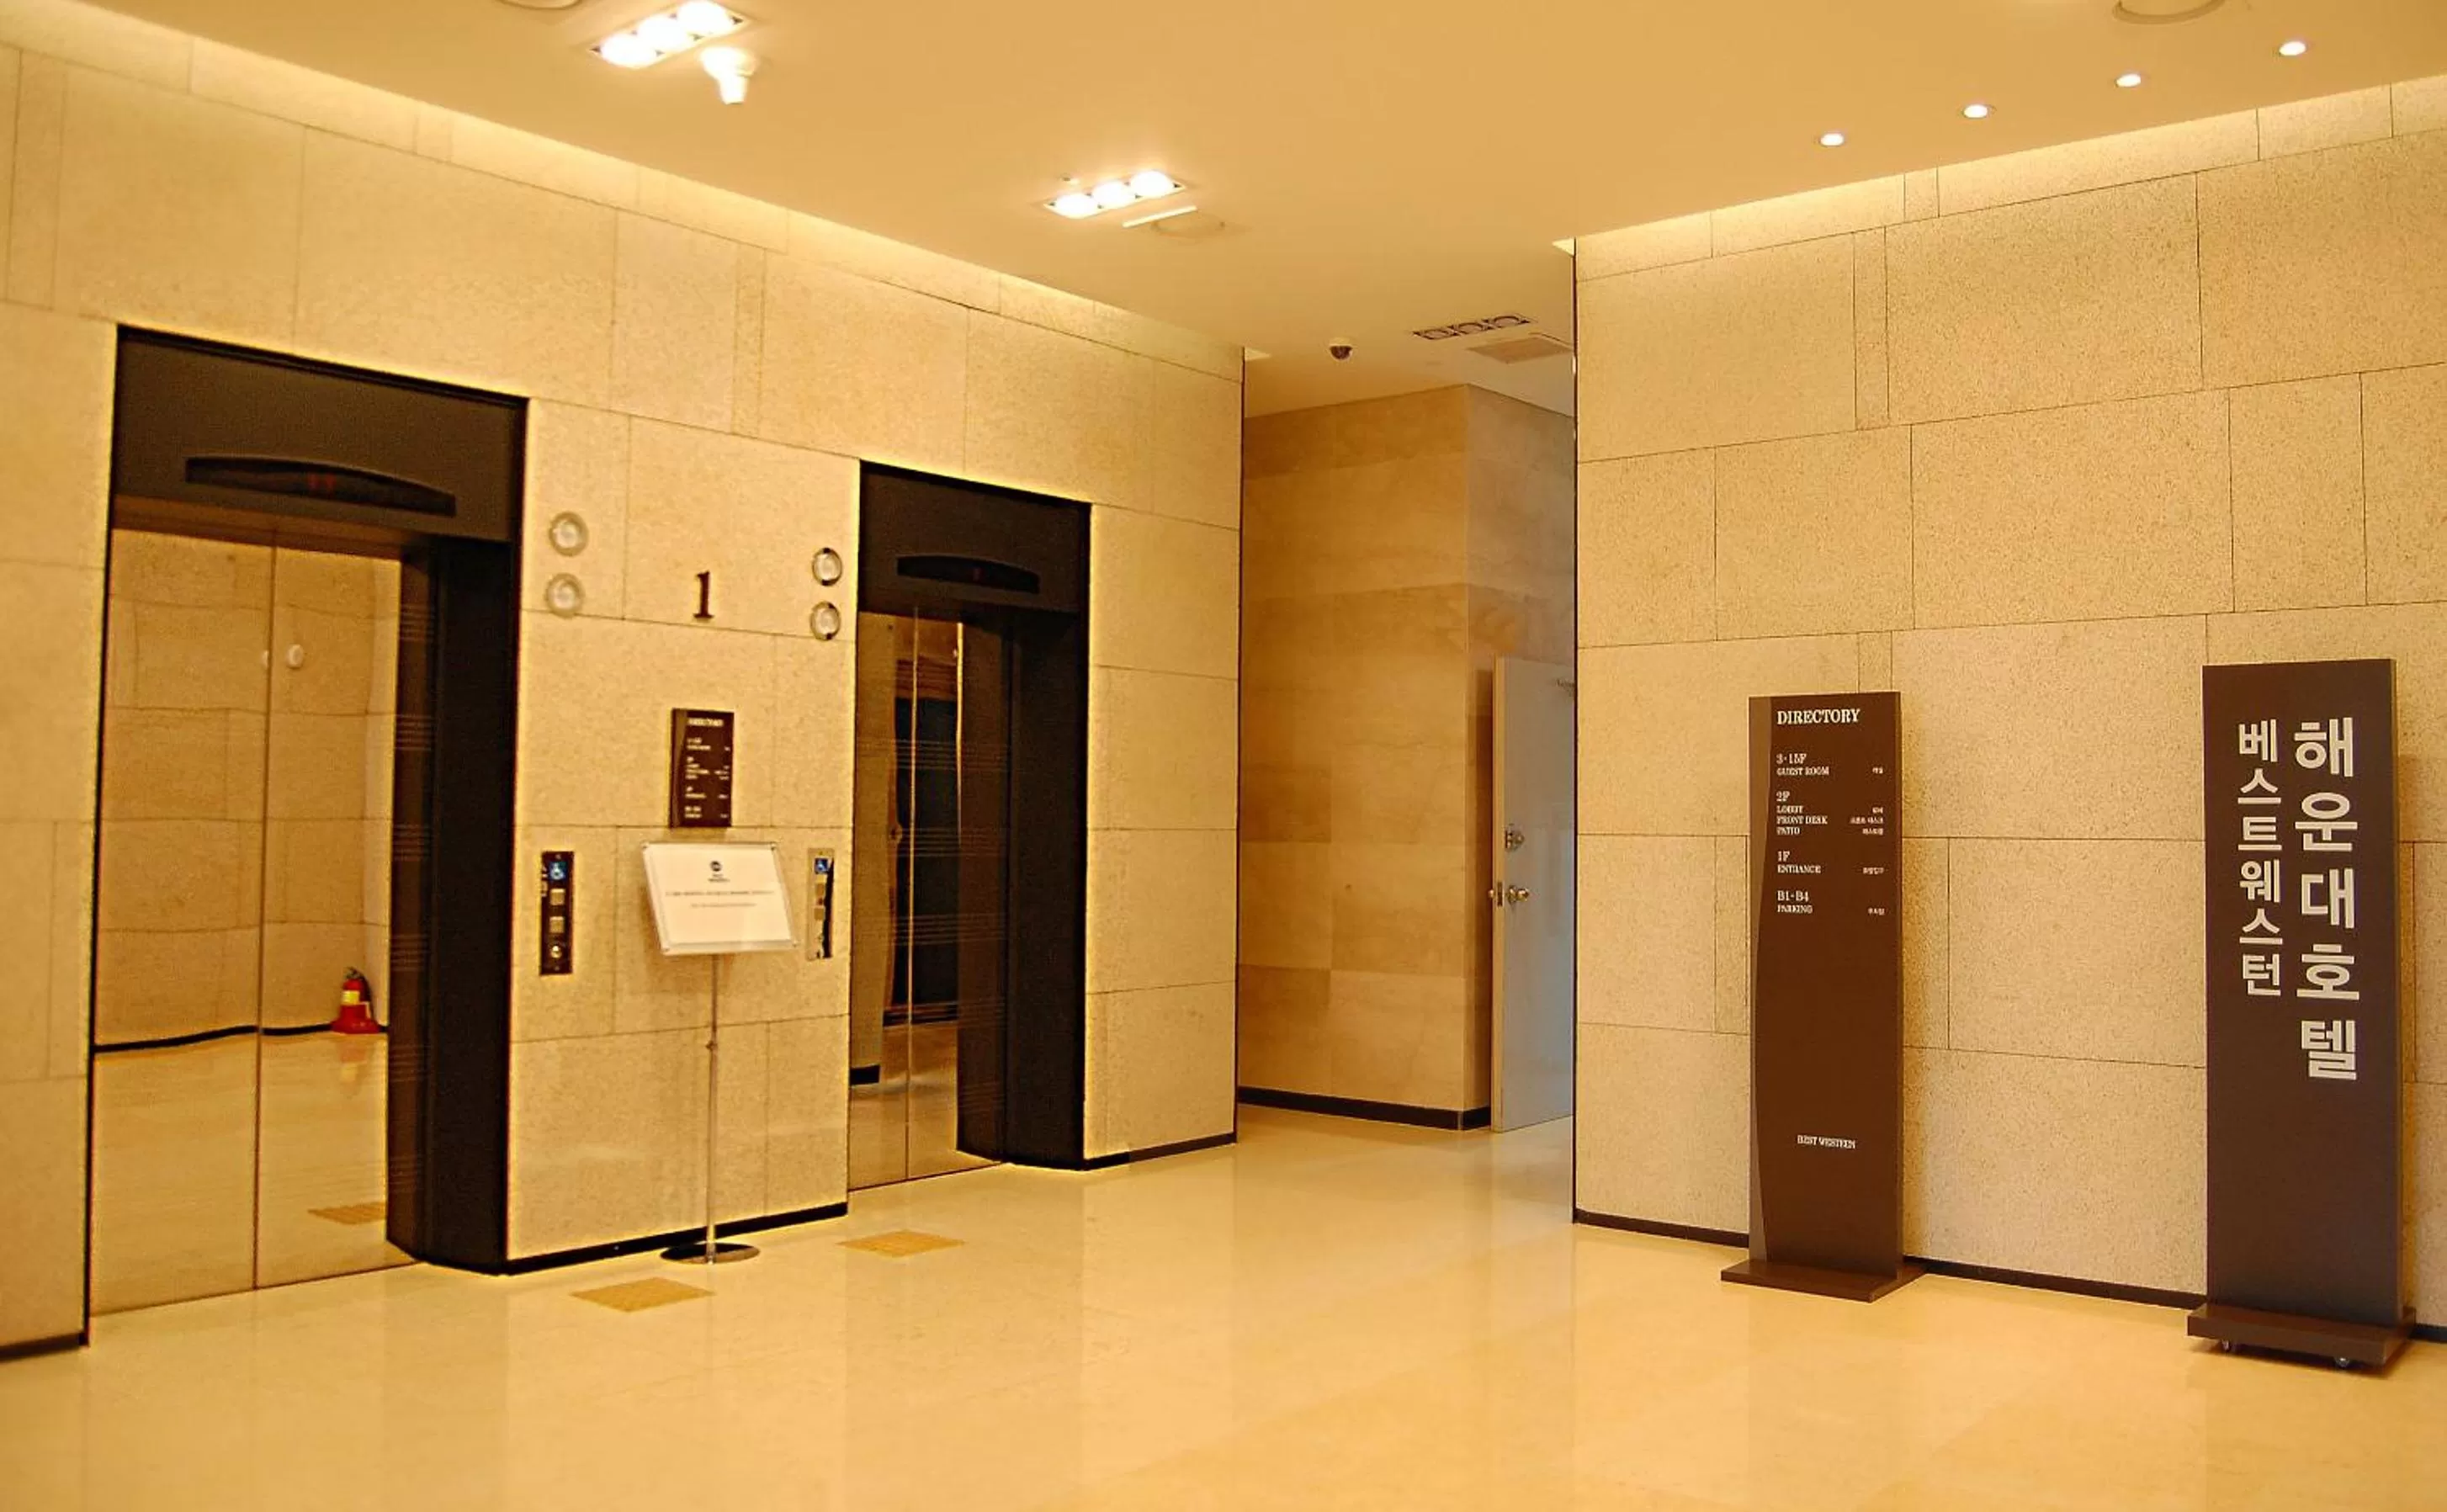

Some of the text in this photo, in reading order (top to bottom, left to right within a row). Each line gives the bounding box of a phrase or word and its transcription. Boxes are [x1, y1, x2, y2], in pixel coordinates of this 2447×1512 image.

[693, 570, 714, 619] 1
[1777, 708, 1860, 725] DIRECTORY
[1777, 851, 1791, 862] 1F
[2237, 719, 2283, 997] 베스트웨스턴
[1777, 864, 1822, 874] ENTRANCE
[2294, 717, 2359, 1080] 해운대호텔
[1797, 1135, 1818, 1145] BEST
